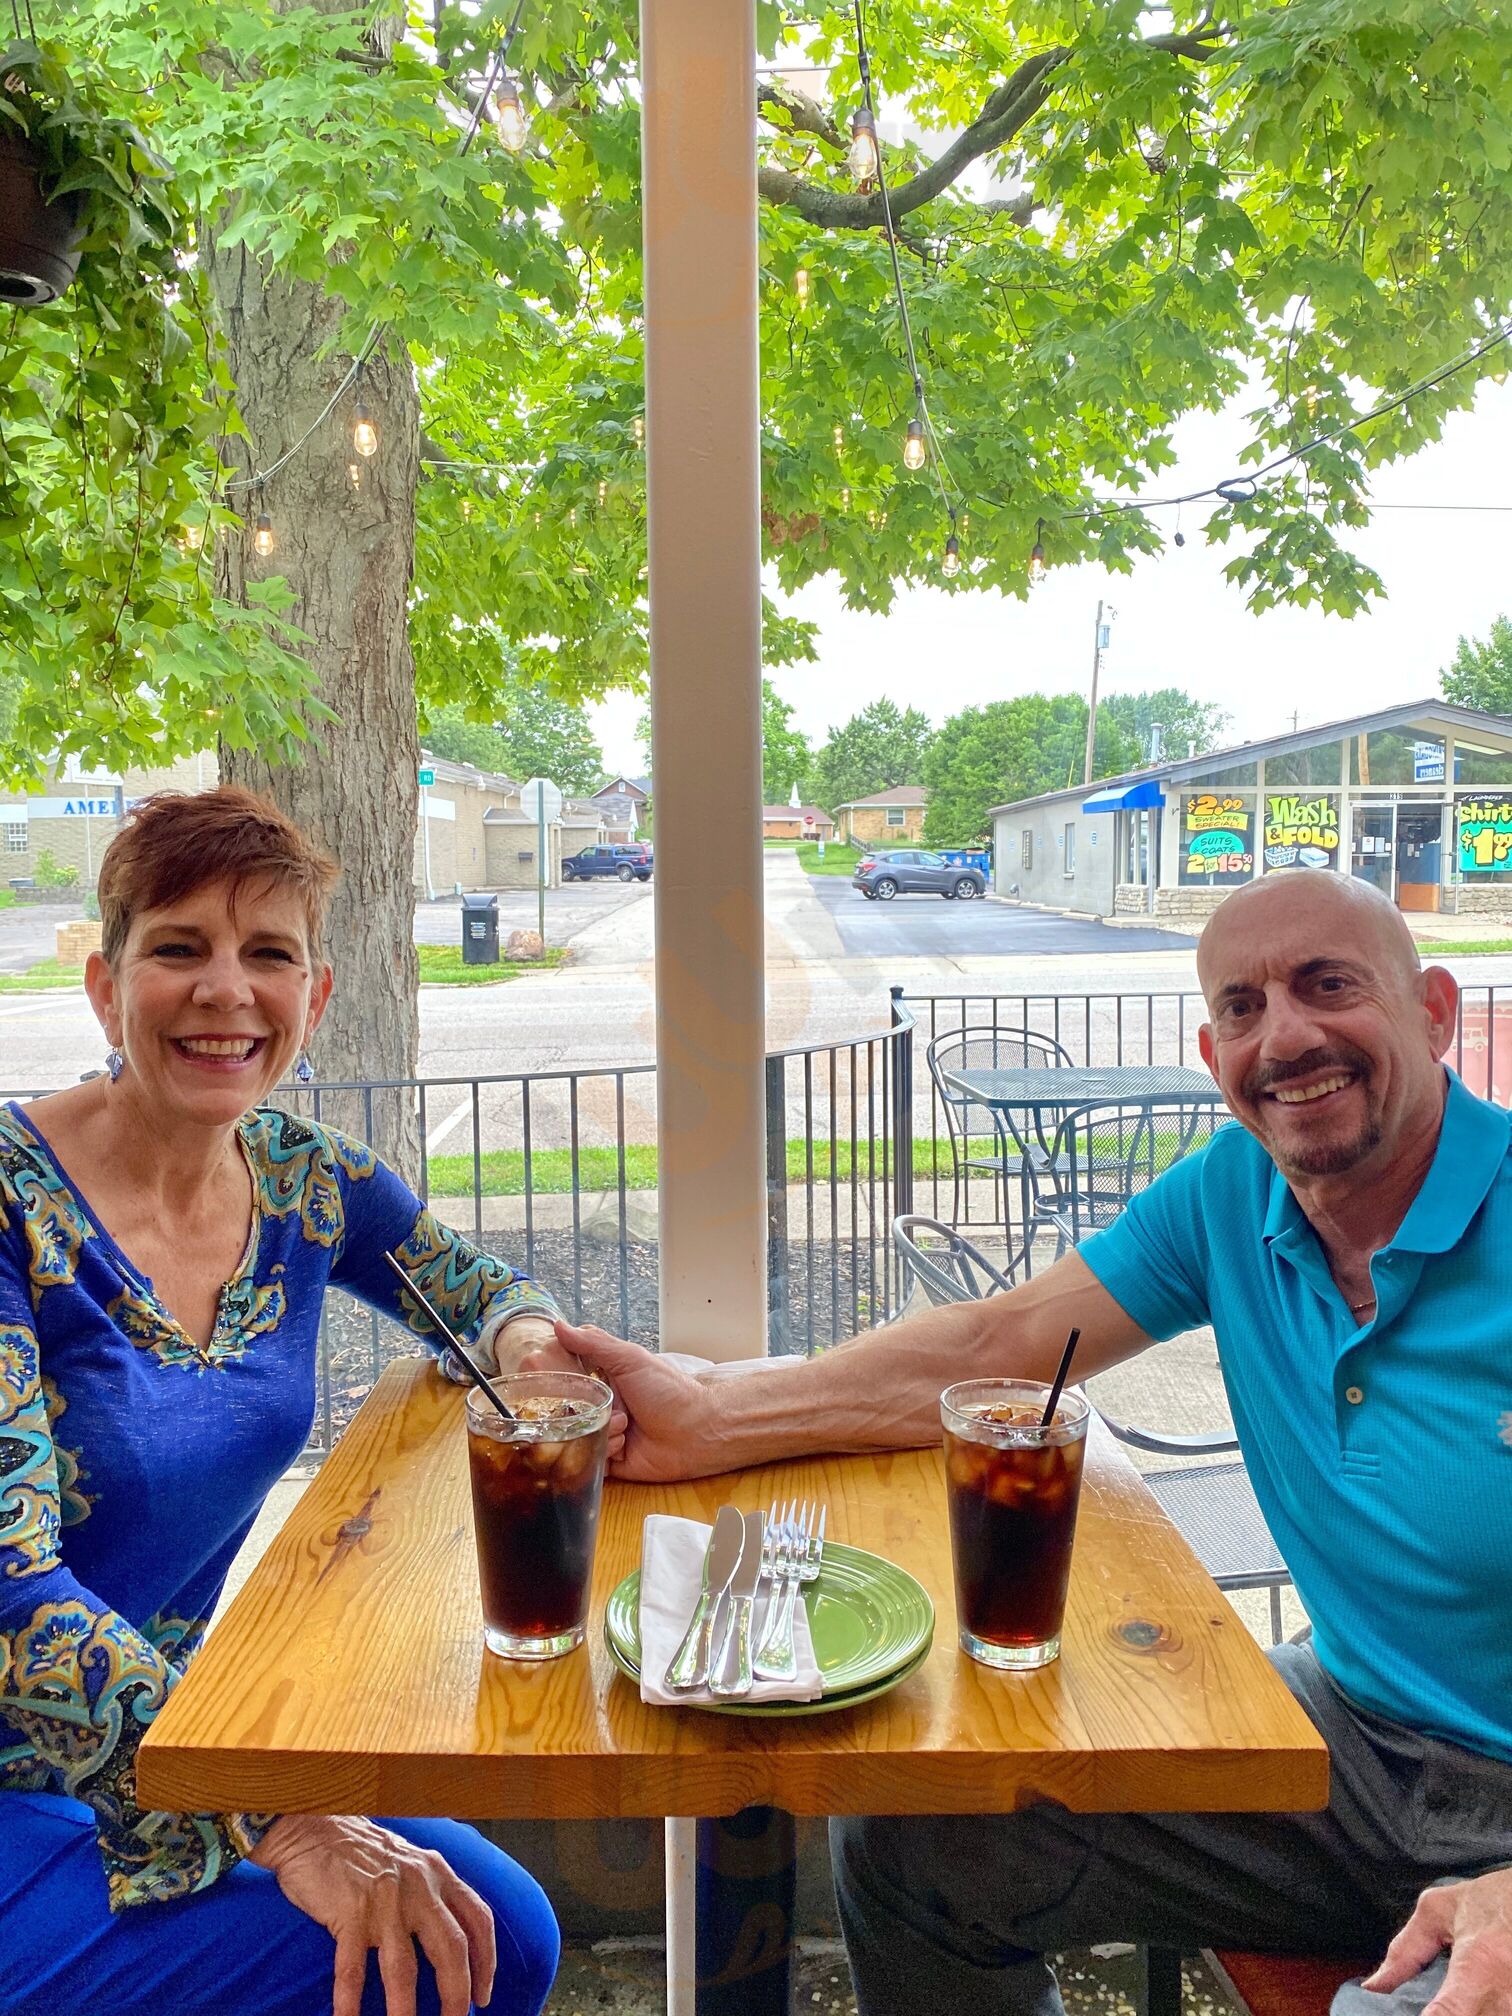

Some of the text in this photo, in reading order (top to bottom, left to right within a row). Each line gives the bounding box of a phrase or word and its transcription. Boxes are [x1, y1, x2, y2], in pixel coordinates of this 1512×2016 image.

[1187, 794, 1243, 815] $2.99
[1268, 796, 1337, 827] Wash
[1201, 836, 1232, 846] SUITS
[1282, 825, 1338, 849] FOLD
[1200, 846, 1235, 854] COATS
[1187, 854, 1205, 873] 2
